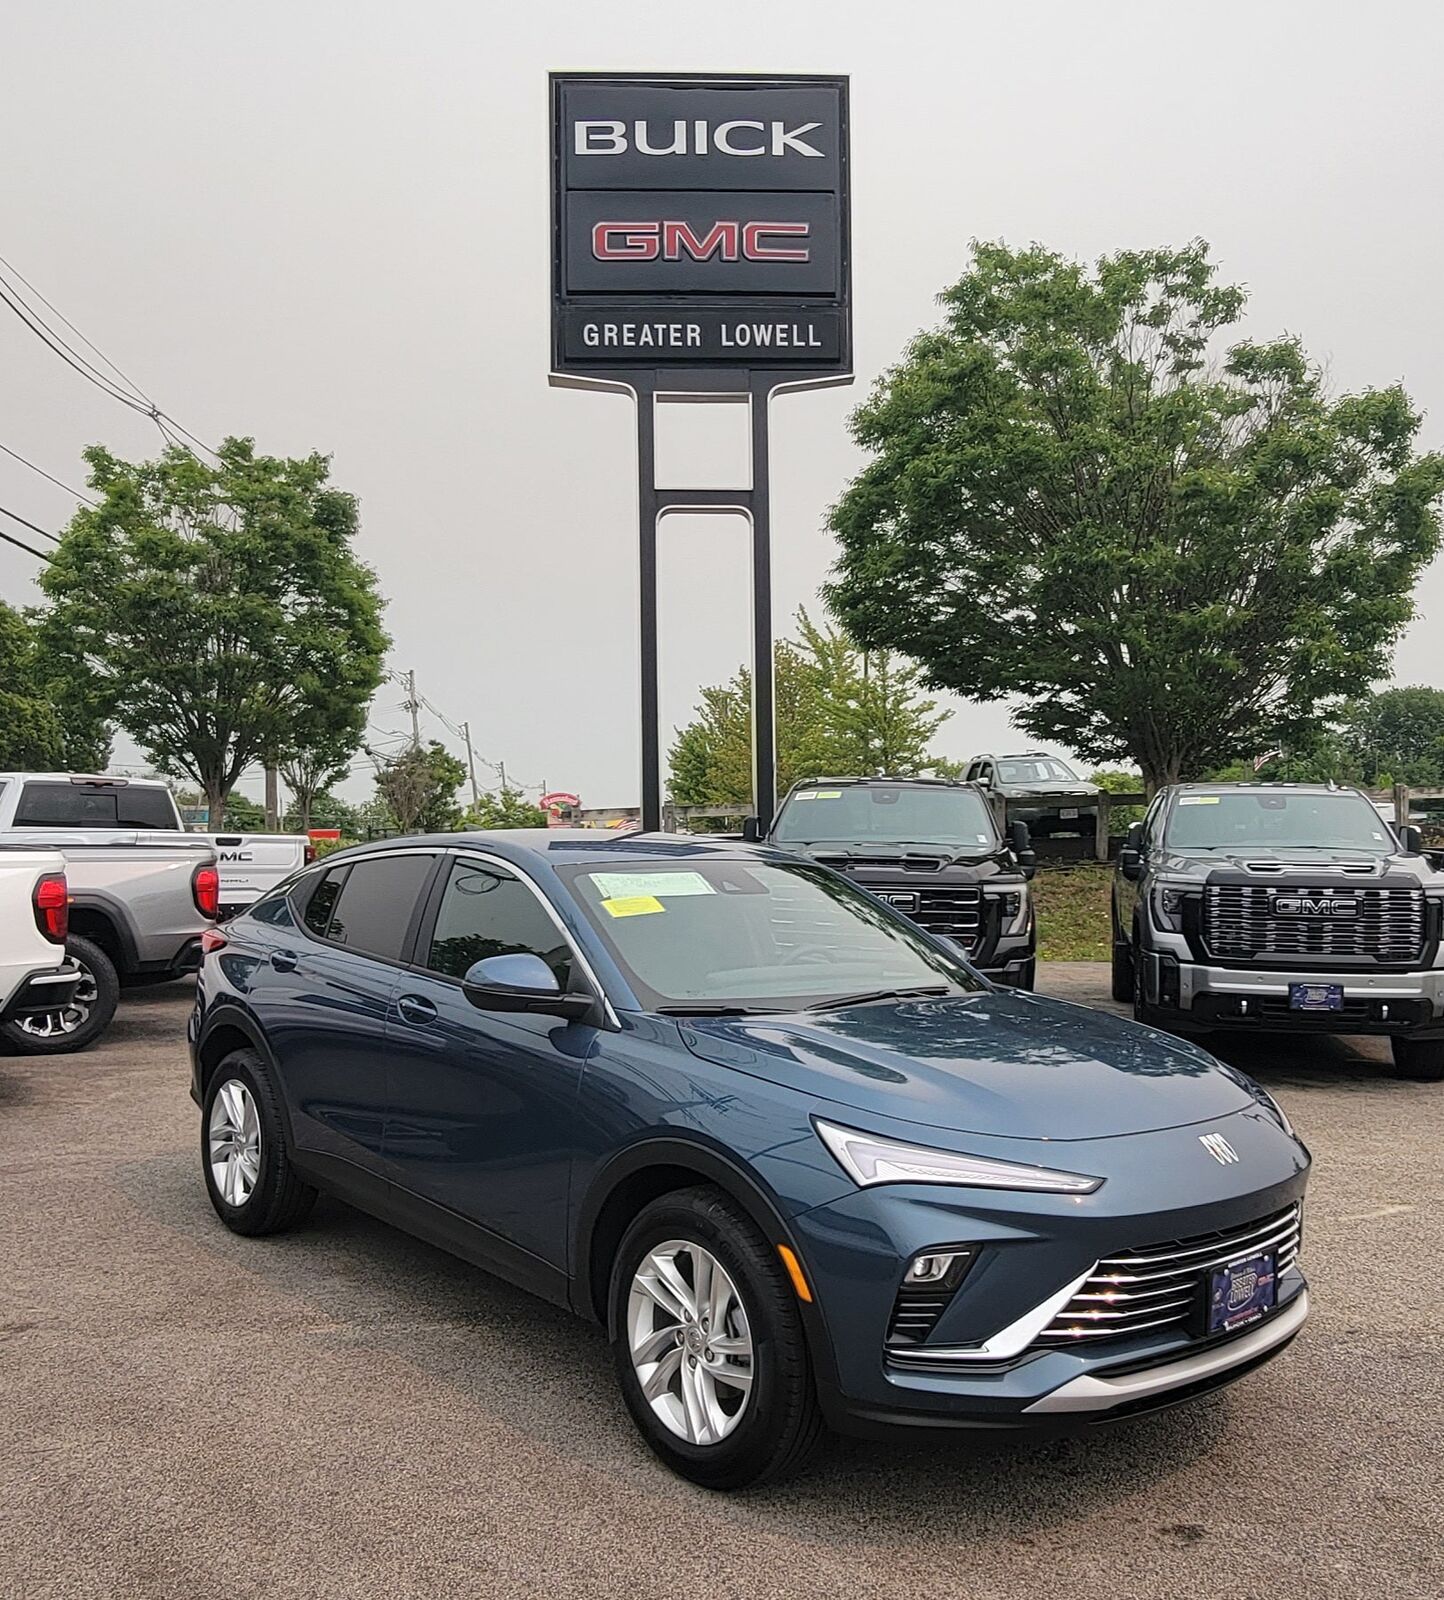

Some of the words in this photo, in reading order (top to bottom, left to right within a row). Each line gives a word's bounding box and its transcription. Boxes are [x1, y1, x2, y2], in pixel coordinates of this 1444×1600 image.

[574, 120, 826, 158] BUICK
[592, 220, 811, 263] GMC
[583, 323, 701, 347] GREATER
[721, 324, 822, 347] LOWELL
[220, 851, 253, 861] MC
[1276, 898, 1357, 915] GMC
